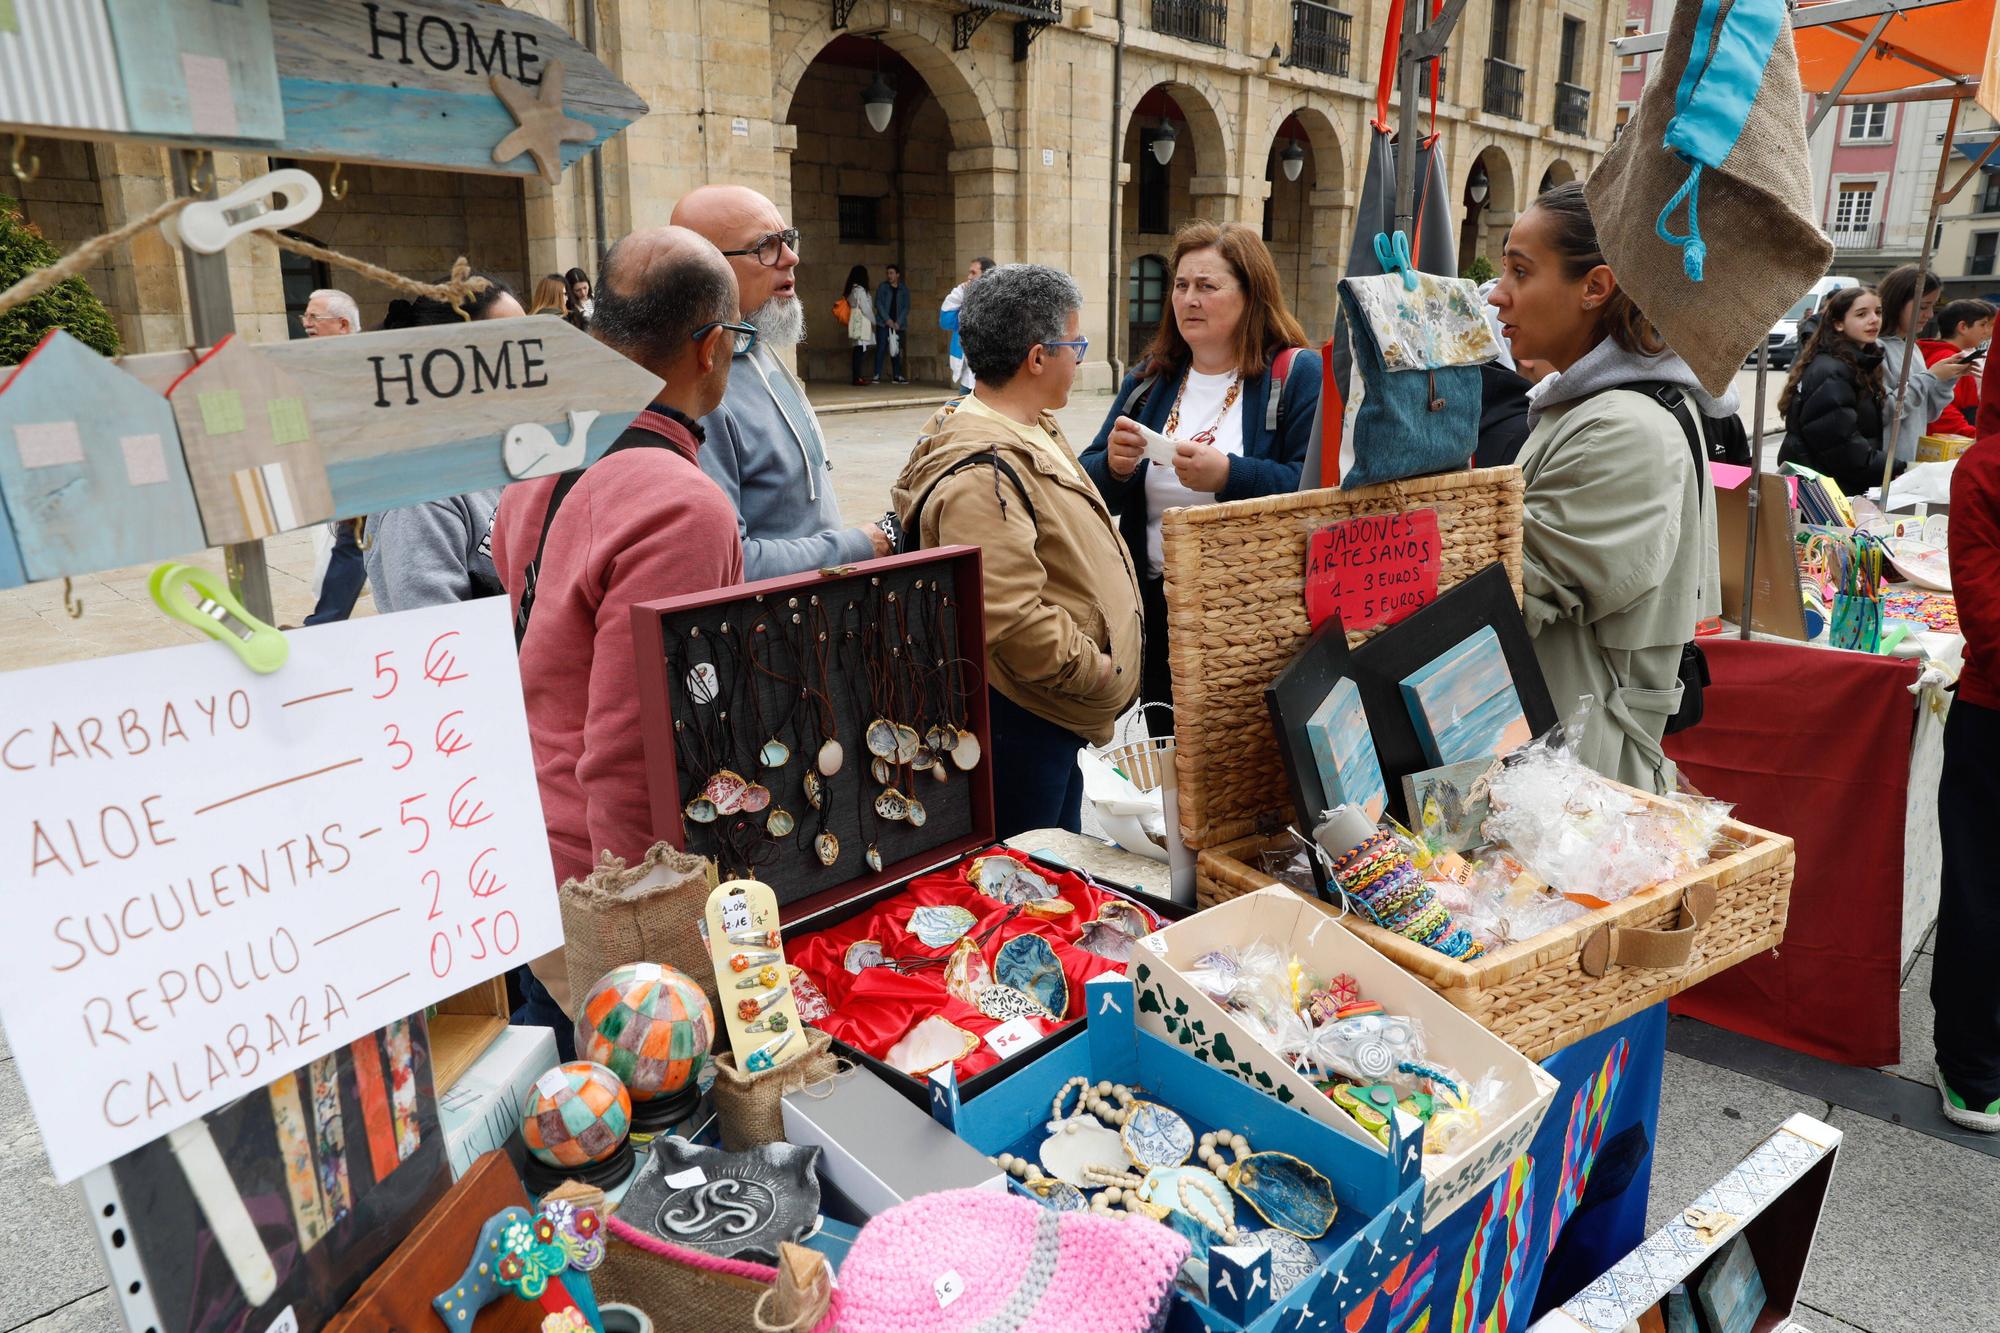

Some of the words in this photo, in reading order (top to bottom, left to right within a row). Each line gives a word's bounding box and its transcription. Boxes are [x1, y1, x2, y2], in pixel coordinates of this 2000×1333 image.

[361, 2, 543, 86] HOME
[367, 338, 549, 408] HOME
[1309, 541, 1430, 577] ARTESANOS
[1324, 512, 1415, 550] JABONES
[1363, 573, 1375, 591] 3
[1378, 566, 1420, 587] EUROS
[1364, 600, 1375, 618] 5
[1380, 590, 1425, 613] EUROS
[1, 689, 251, 771] CARBAYO
[372, 650, 399, 699] 5
[423, 631, 470, 687] €
[31, 795, 177, 878] ALOE
[383, 723, 413, 770] 3
[435, 710, 473, 758] €
[400, 793, 430, 853] 5
[448, 776, 496, 829] €
[82, 927, 300, 1048] REPOLLO
[421, 869, 444, 921] 2
[468, 847, 508, 899] €
[102, 984, 349, 1128] CALABAZA
